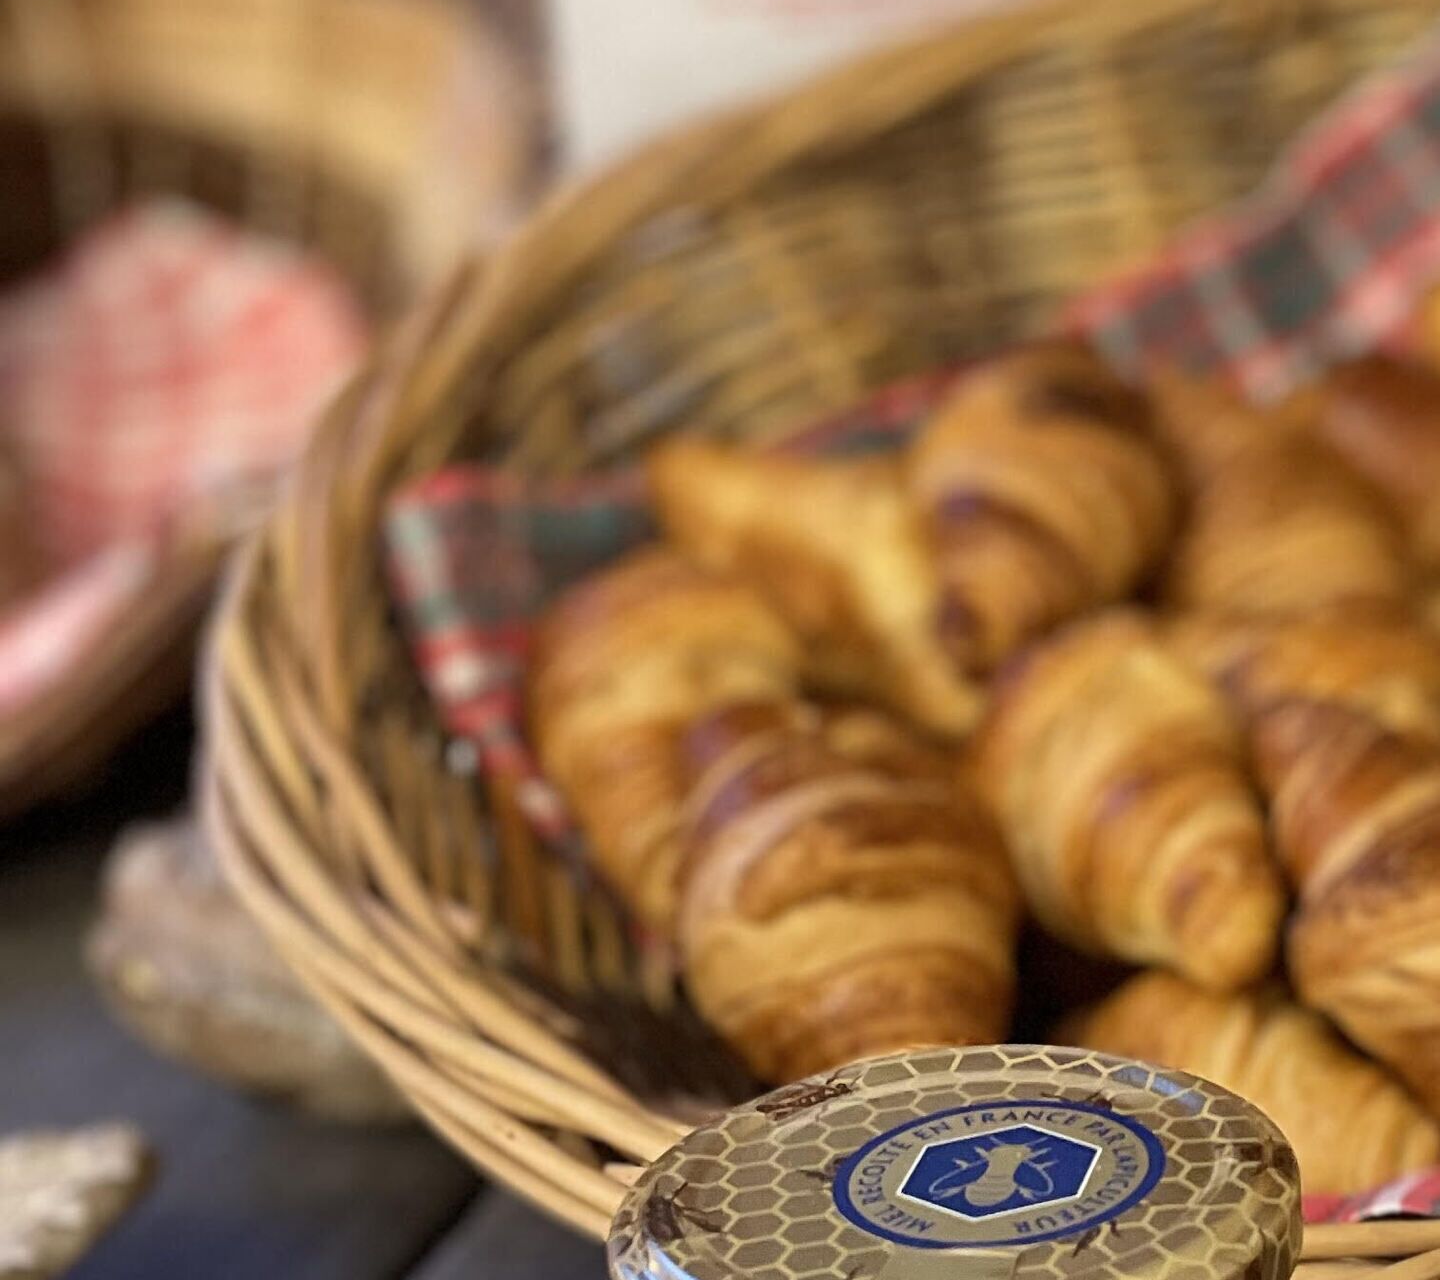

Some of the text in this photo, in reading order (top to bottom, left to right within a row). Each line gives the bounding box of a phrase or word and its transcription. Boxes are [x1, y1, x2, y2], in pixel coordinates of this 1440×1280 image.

[873, 1203, 936, 1234] MIEL
[912, 1120, 952, 1140] EN
[963, 1109, 1083, 1127] FRANCE
